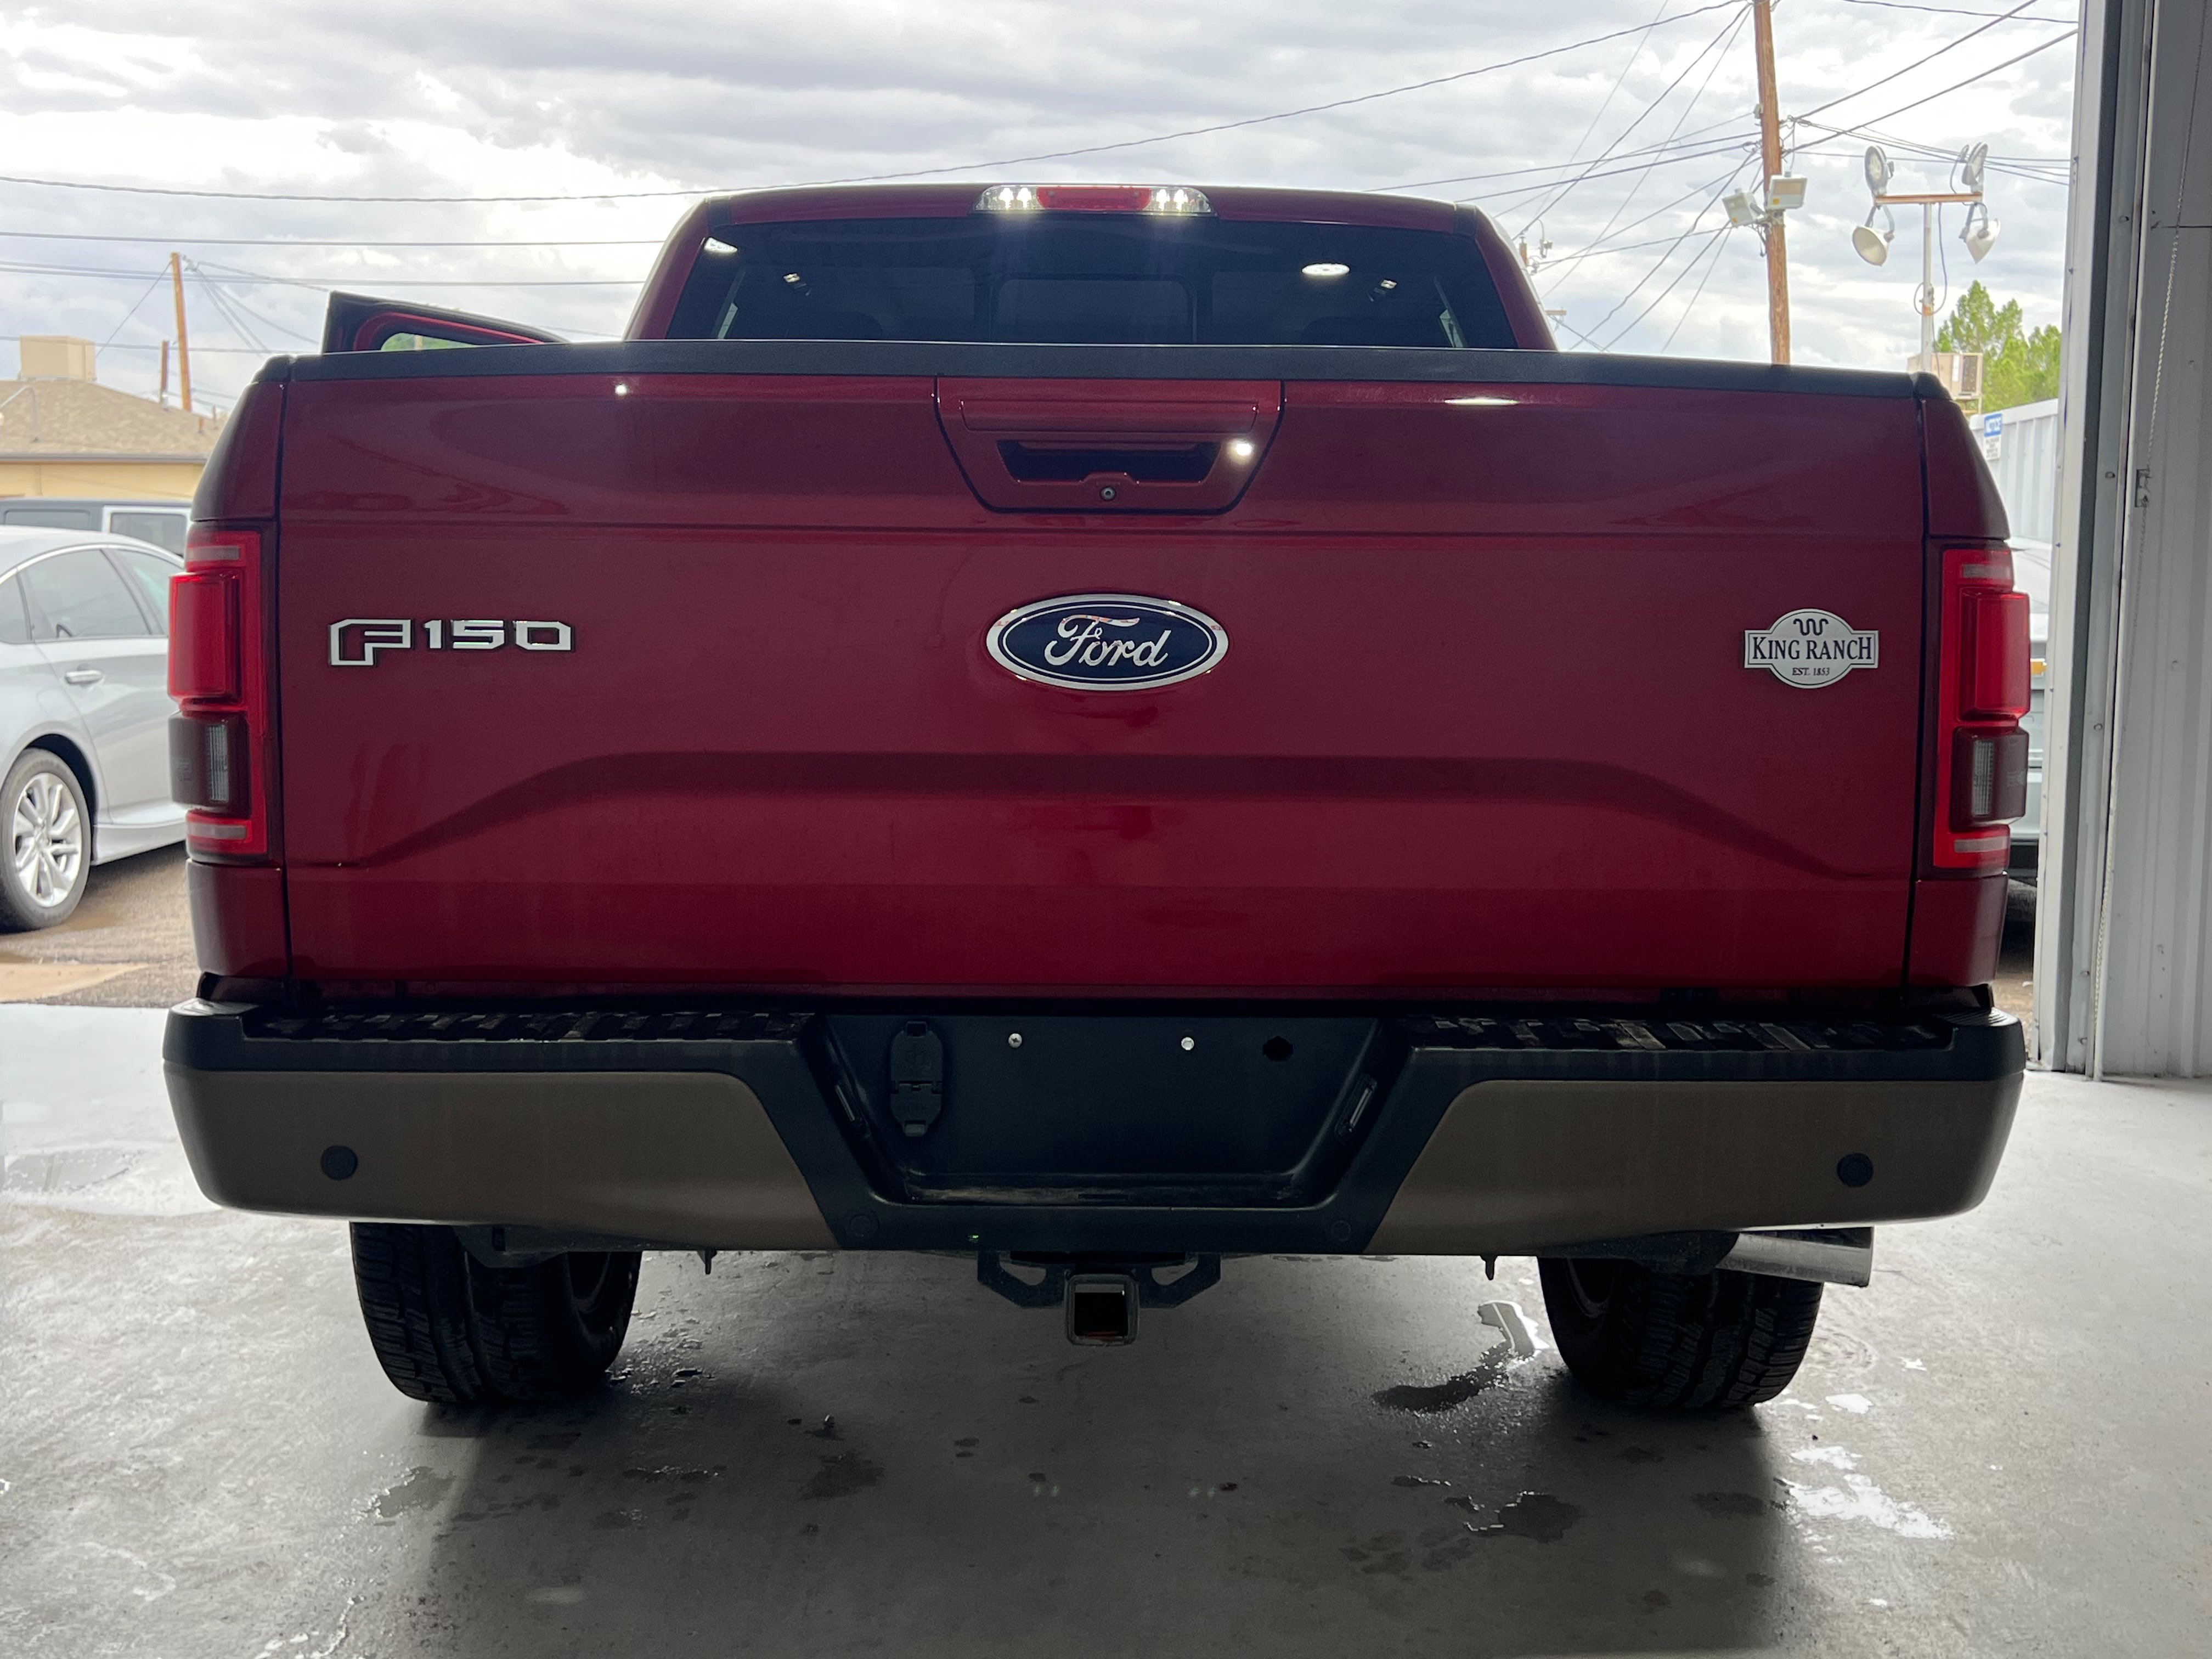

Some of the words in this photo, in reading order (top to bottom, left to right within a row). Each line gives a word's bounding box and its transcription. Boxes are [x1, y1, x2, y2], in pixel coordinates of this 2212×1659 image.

[1044, 614, 1171, 667] Ford
[1752, 636, 1800, 660] KING
[1806, 636, 1872, 660] RANCH
[1792, 667, 1810, 676] EST.
[1813, 667, 1830, 676] 1853
